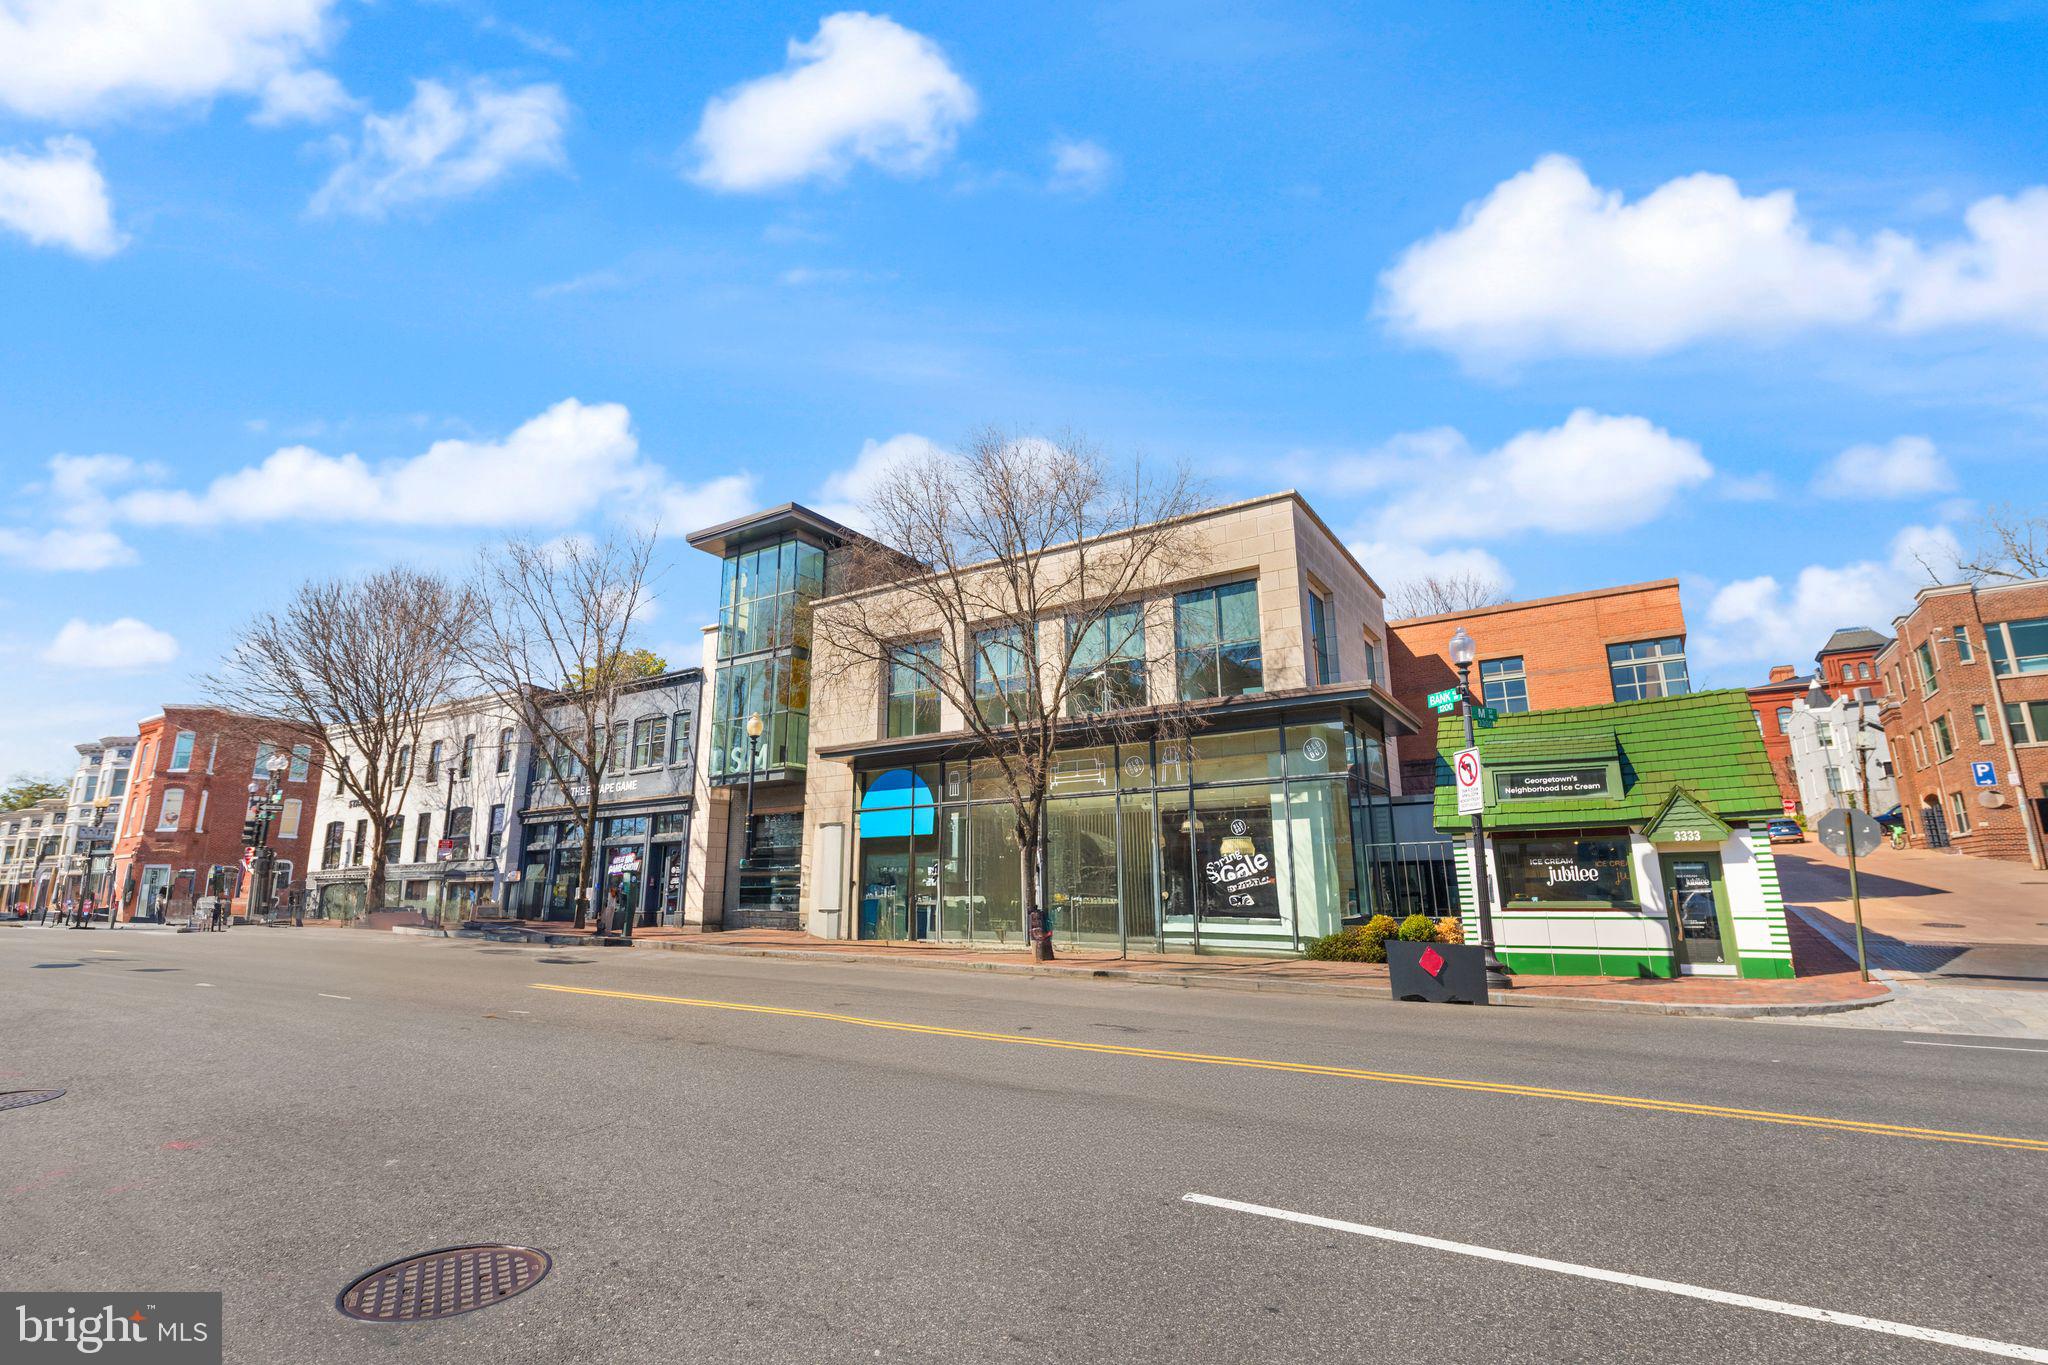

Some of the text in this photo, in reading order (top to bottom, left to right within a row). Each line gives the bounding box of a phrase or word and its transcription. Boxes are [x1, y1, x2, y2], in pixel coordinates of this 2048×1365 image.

[1430, 691, 1451, 706] BANK
[1477, 708, 1486, 719] M
[1976, 764, 1990, 777] P
[1524, 774, 1578, 785] Georgetown's
[571, 780, 638, 796] THE EAPE GAME
[1504, 785, 1560, 795] Neighborhood
[1574, 782, 1601, 790] Cream
[1674, 830, 1701, 841] 3333
[1546, 865, 1599, 886] jubilee
